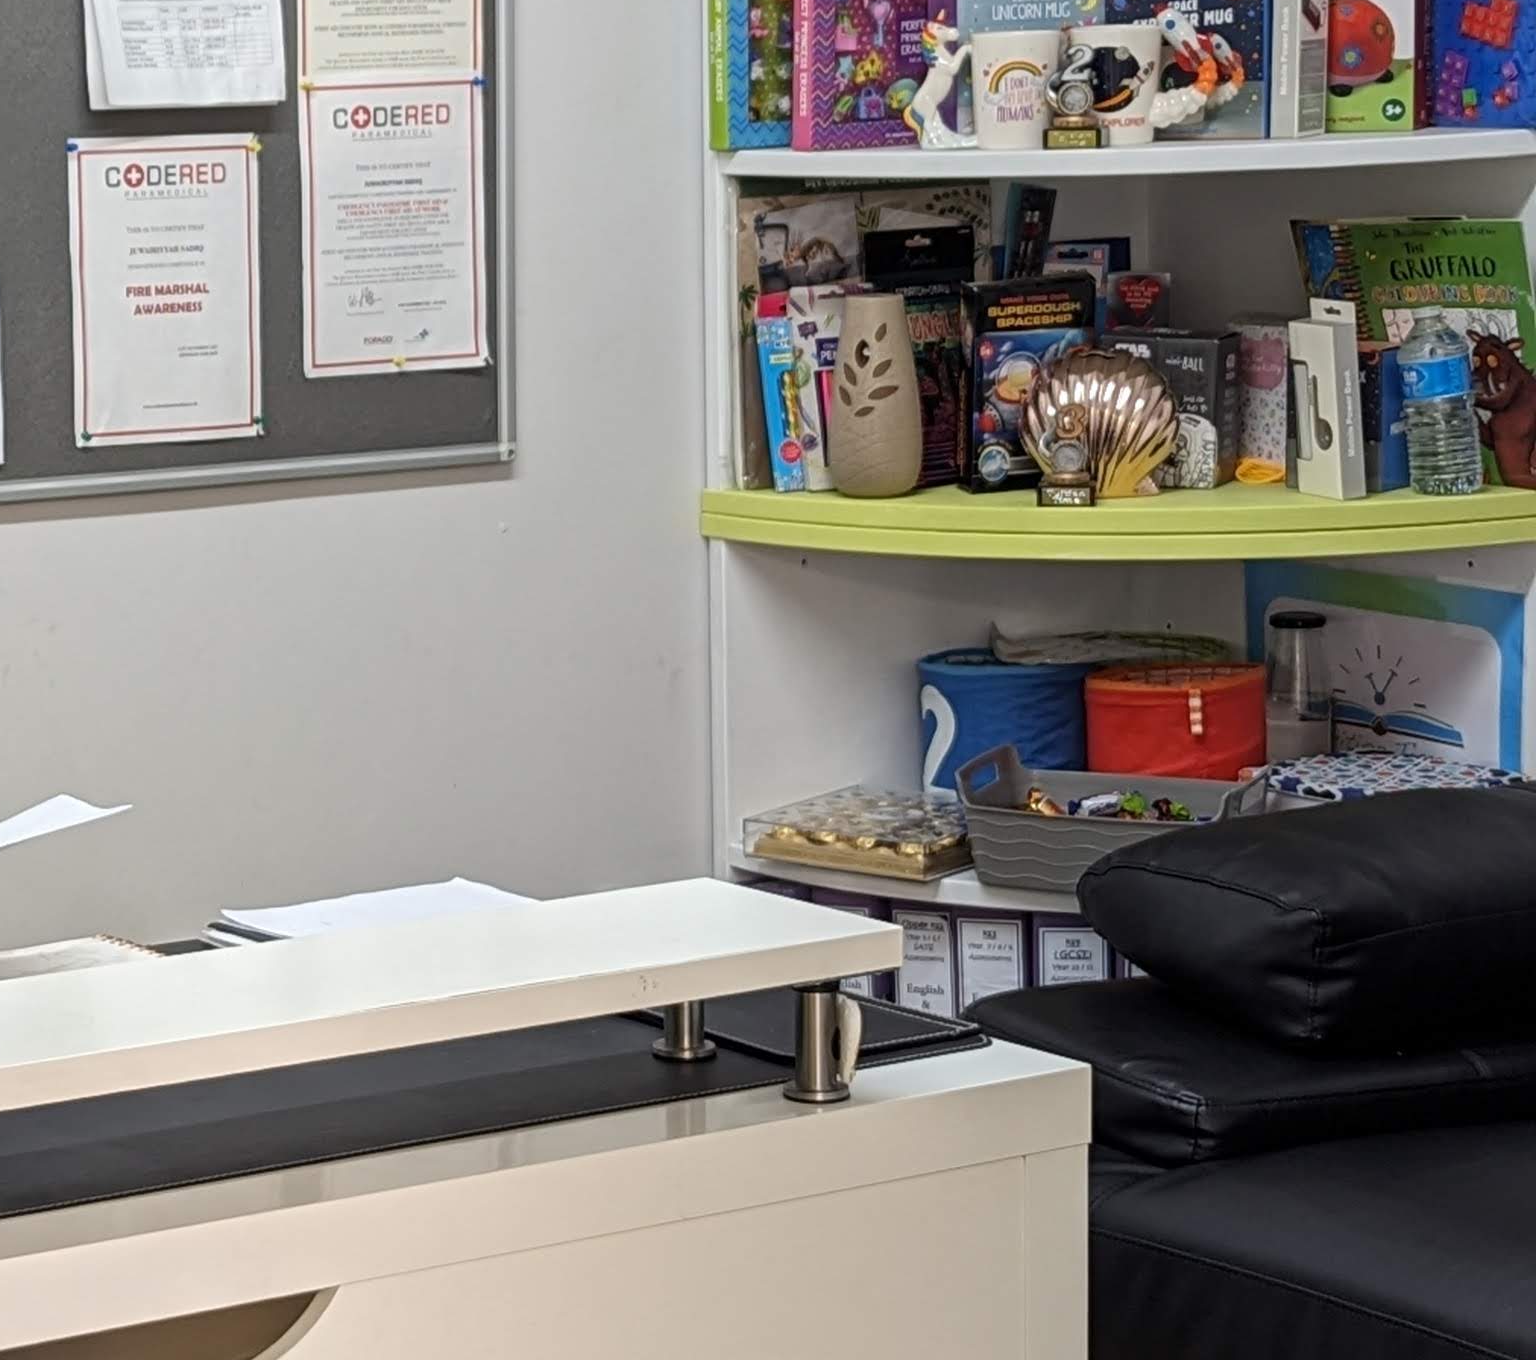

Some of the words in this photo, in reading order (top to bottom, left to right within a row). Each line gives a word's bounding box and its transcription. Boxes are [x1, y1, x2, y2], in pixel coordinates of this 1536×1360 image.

[992, 1, 1043, 22] UNICORN
[1044, 1, 1072, 20] MUG
[1202, 7, 1234, 27] MUG
[1061, 43, 1094, 82] 2
[1382, 102, 1404, 118] 5+
[1389, 255, 1497, 282] GRUFFALO
[126, 286, 152, 299] FIRE
[154, 283, 210, 296] MARSHAL
[1371, 283, 1472, 305] COLOURING
[1473, 282, 1521, 305] BOOK
[134, 301, 203, 316] AWARENESS
[987, 301, 1082, 318] SUPERDOUGH
[996, 313, 1073, 330] SPACESHIP
[1054, 403, 1090, 440] 3
[907, 983, 945, 996] English
